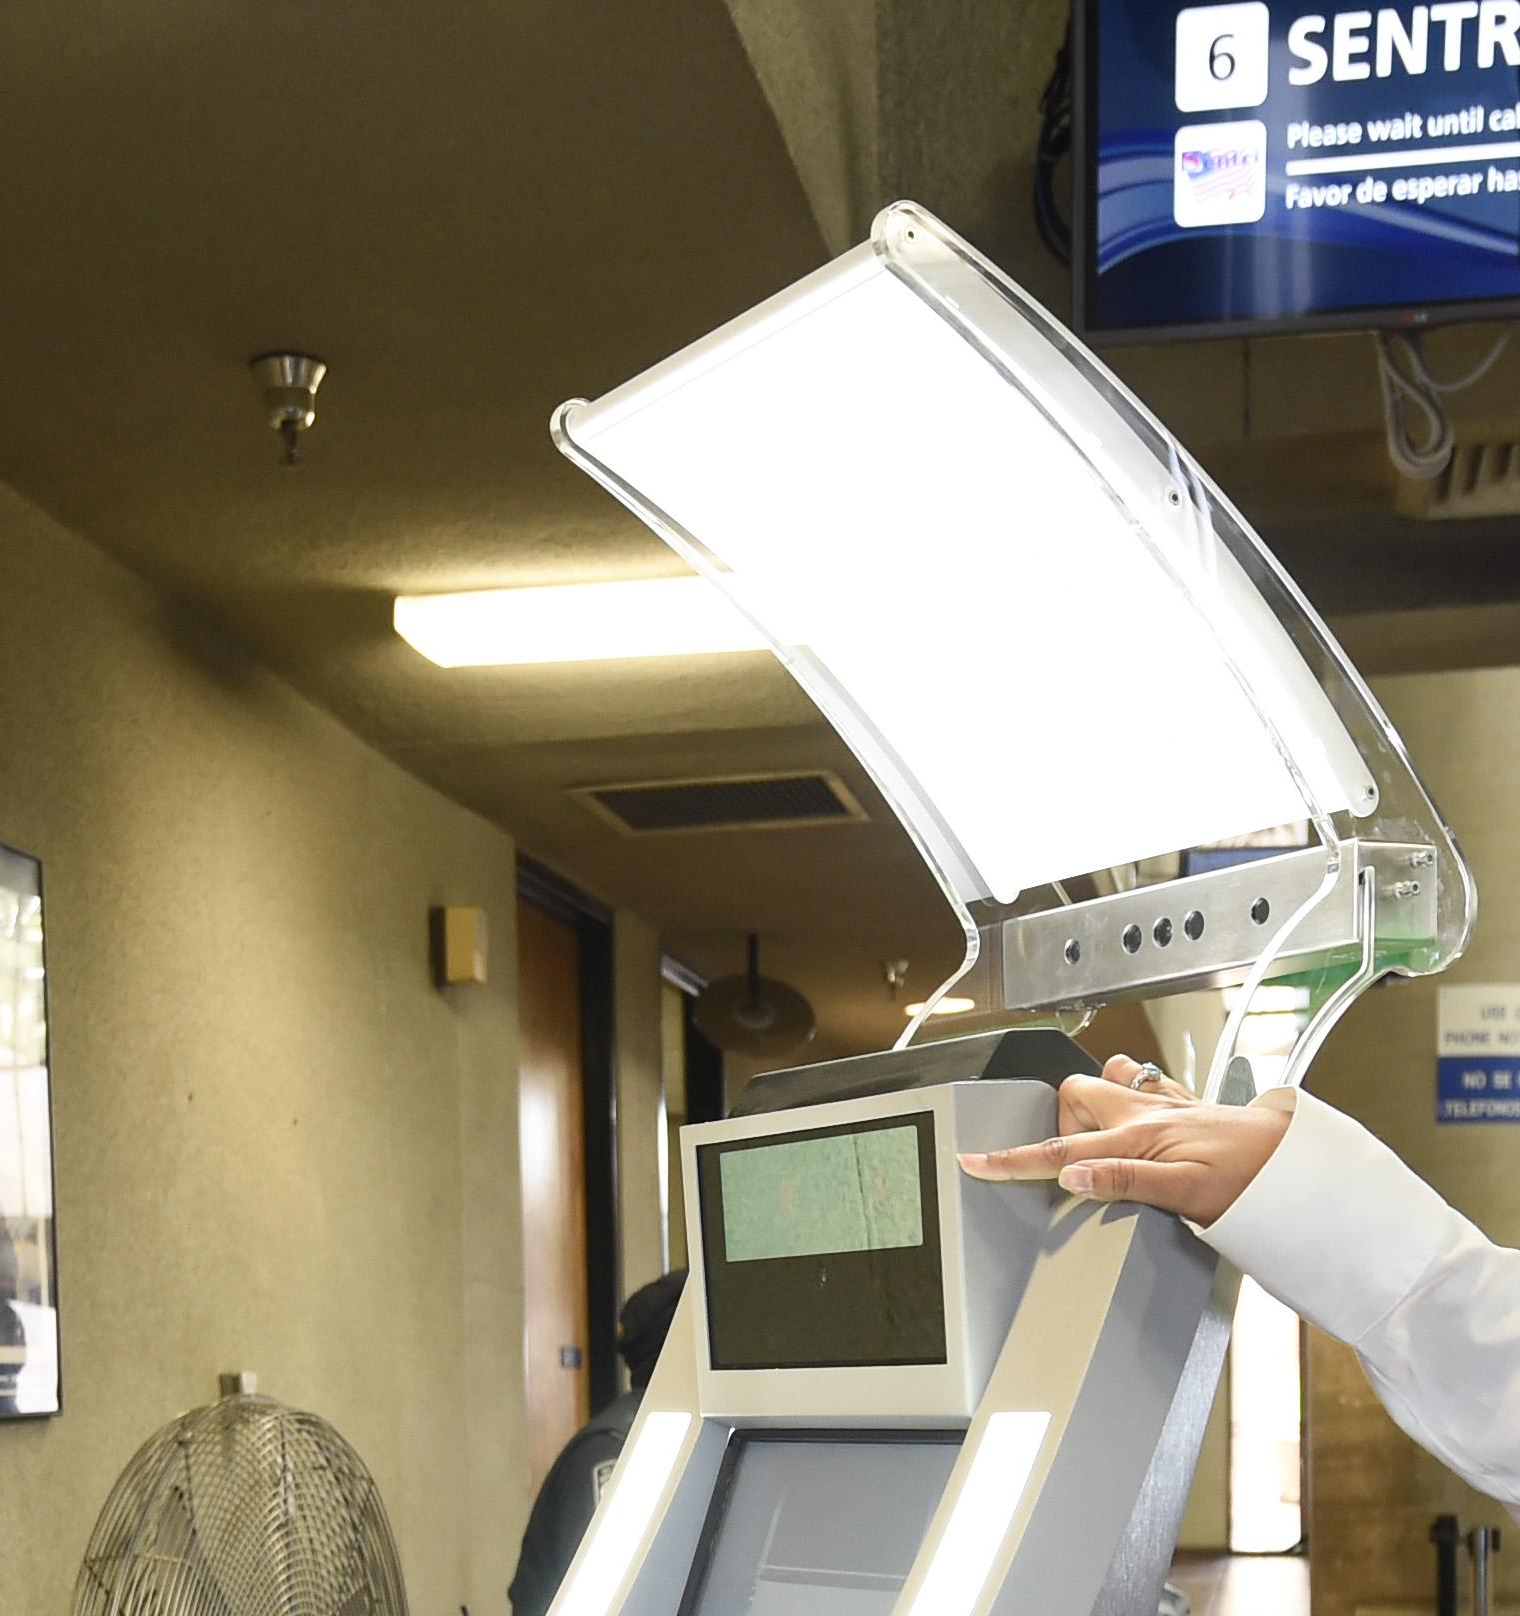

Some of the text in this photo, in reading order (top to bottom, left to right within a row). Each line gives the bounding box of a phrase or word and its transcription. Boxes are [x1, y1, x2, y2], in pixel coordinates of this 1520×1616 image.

[1208, 33, 1236, 80] 6
[1287, 119, 1363, 149] Please
[1367, 111, 1423, 142] wait
[1428, 104, 1484, 138] until
[1285, 184, 1352, 210] Favor
[1356, 175, 1387, 203] de
[1391, 172, 1483, 205] esperar
[1463, 1070, 1487, 1090] NO
